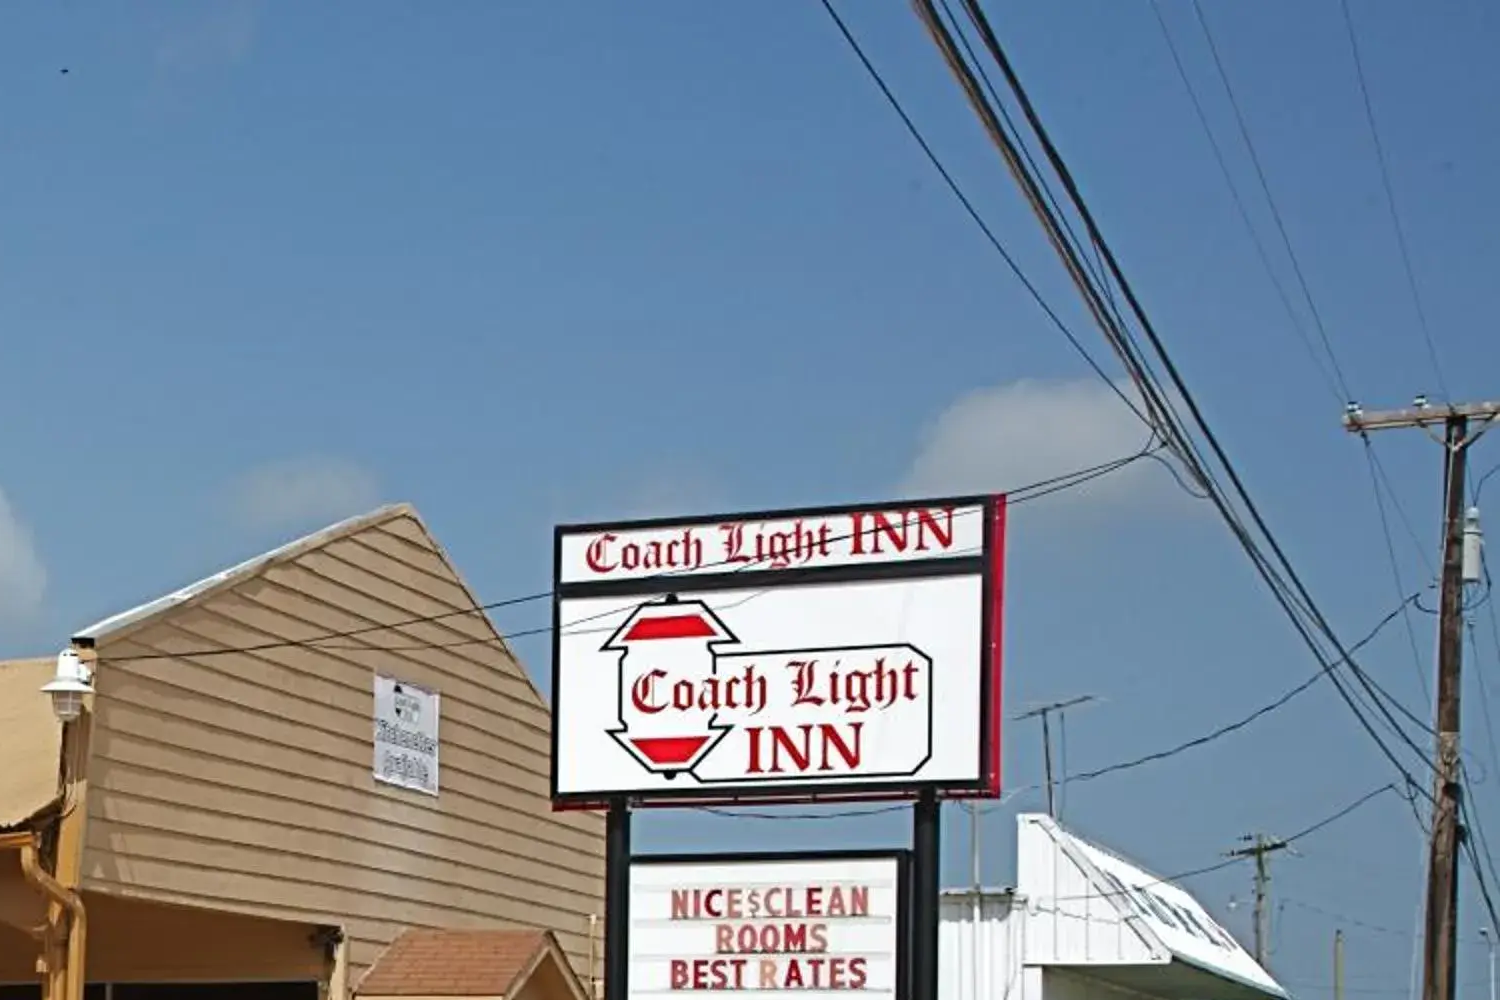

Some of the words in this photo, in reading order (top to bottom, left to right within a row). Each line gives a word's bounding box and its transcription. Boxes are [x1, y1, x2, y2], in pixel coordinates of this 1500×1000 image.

[586, 528, 702, 573] Coach
[719, 515, 832, 569] Light
[850, 505, 955, 555] INN
[632, 664, 767, 716] Coach
[786, 657, 920, 713] Light
[744, 721, 864, 773] INN
[715, 923, 828, 954] ROOMS
[670, 959, 747, 990] BEST
[759, 957, 867, 989] RATES
